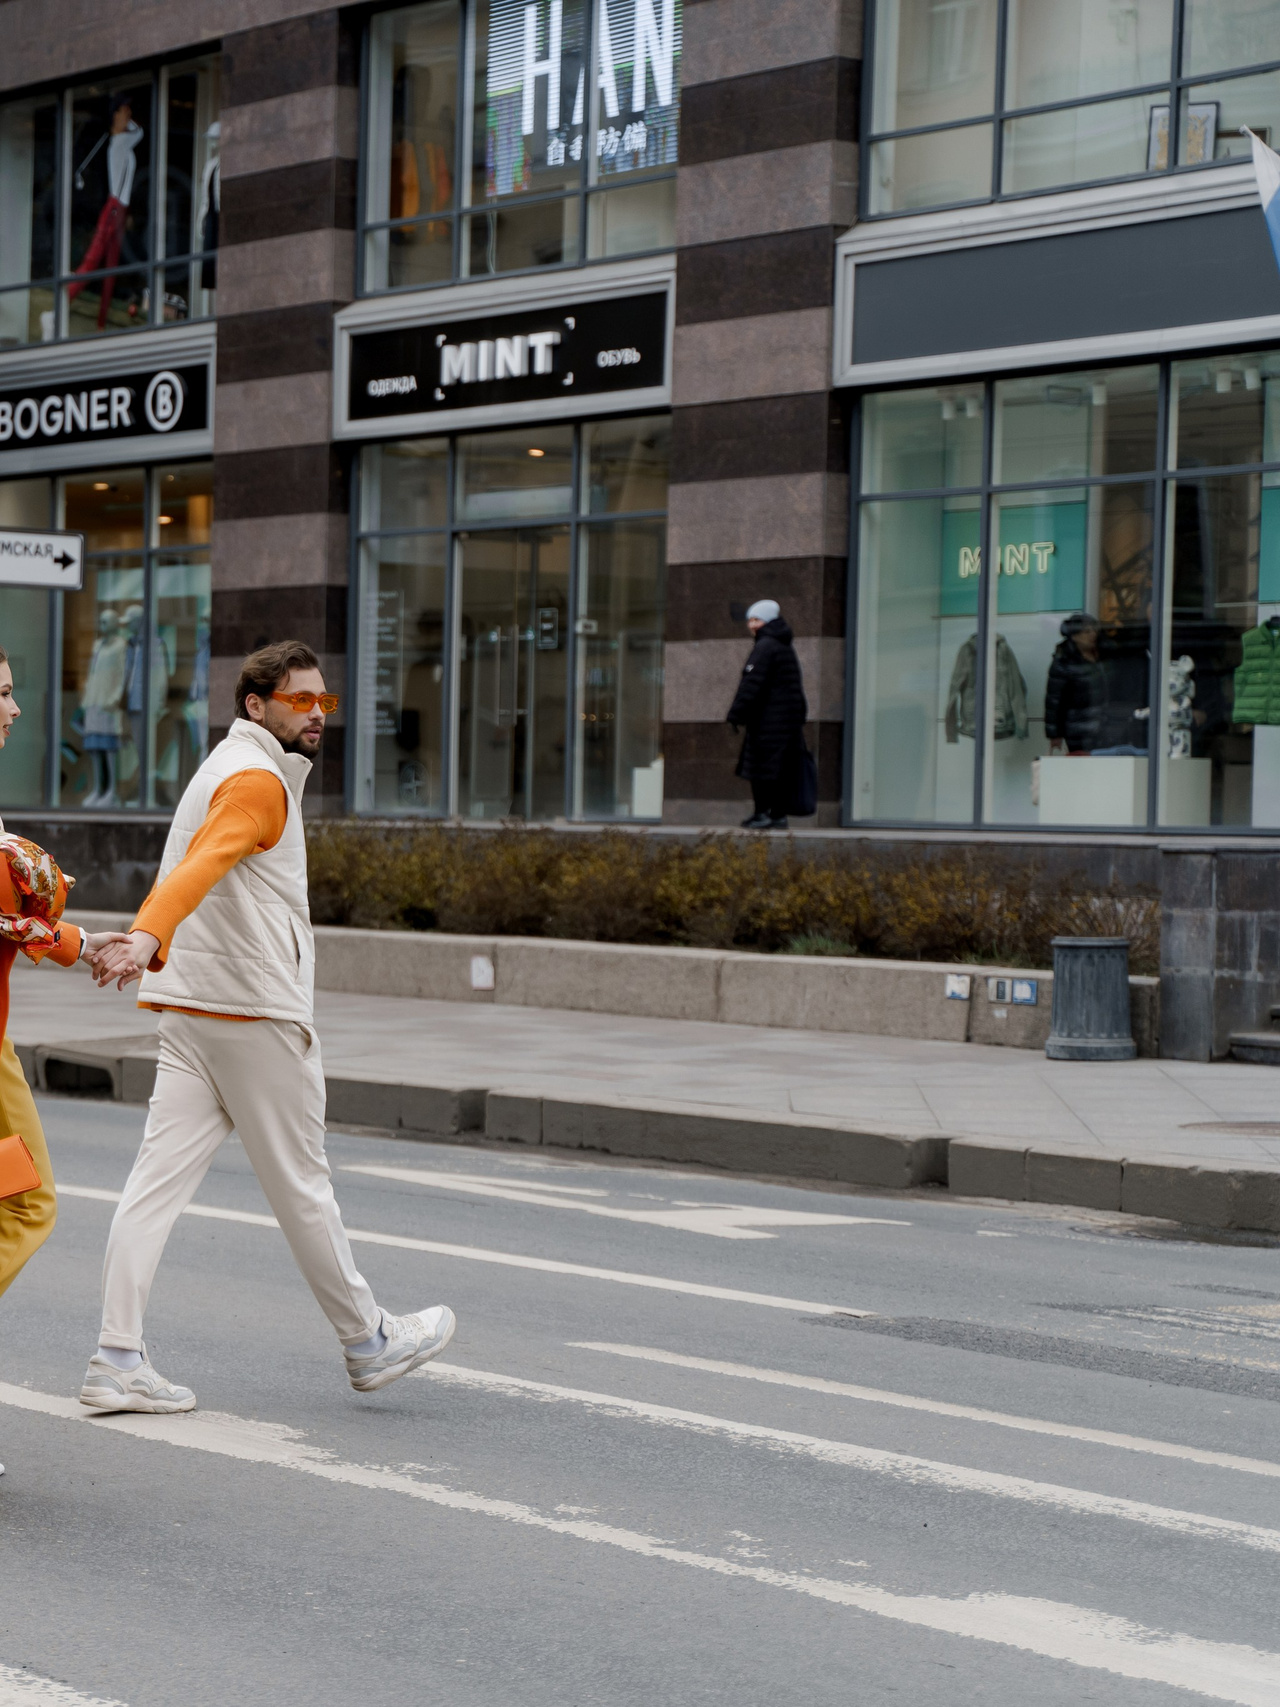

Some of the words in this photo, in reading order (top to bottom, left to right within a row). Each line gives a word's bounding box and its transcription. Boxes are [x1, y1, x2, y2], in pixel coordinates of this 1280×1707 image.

[440, 331, 561, 386] MINT
[597, 347, 641, 368] ОБУВЬ
[368, 375, 418, 397] ОДЕЖДА
[959, 541, 1055, 578] MNT
